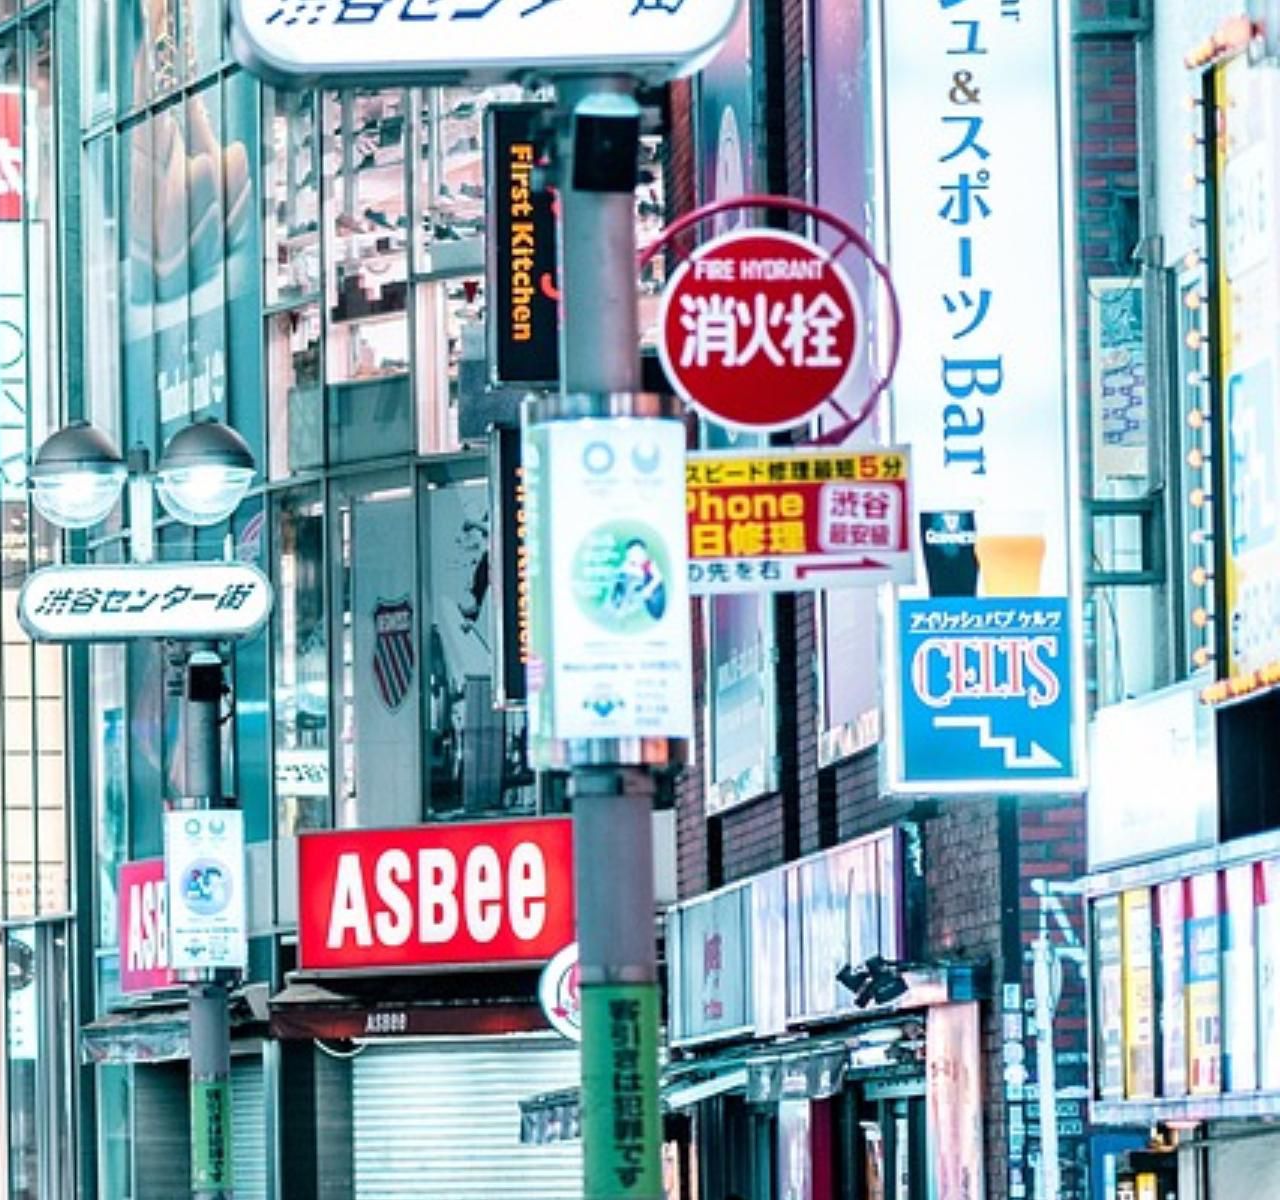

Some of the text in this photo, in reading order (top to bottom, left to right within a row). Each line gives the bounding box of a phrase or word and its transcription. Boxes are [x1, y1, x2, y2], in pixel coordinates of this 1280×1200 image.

[948, 69, 981, 105] &
[510, 143, 535, 341] First Kitchen
[939, 114, 992, 340] スポーツ
[694, 259, 824, 281] FIRE HYDRANT
[679, 291, 845, 368] 消火栓
[942, 354, 1003, 475] Bar
[830, 490, 888, 518] 渋谷
[34, 582, 256, 616] 渋谷センター街
[910, 634, 1061, 709] CELTS
[327, 841, 547, 949] ASBee
